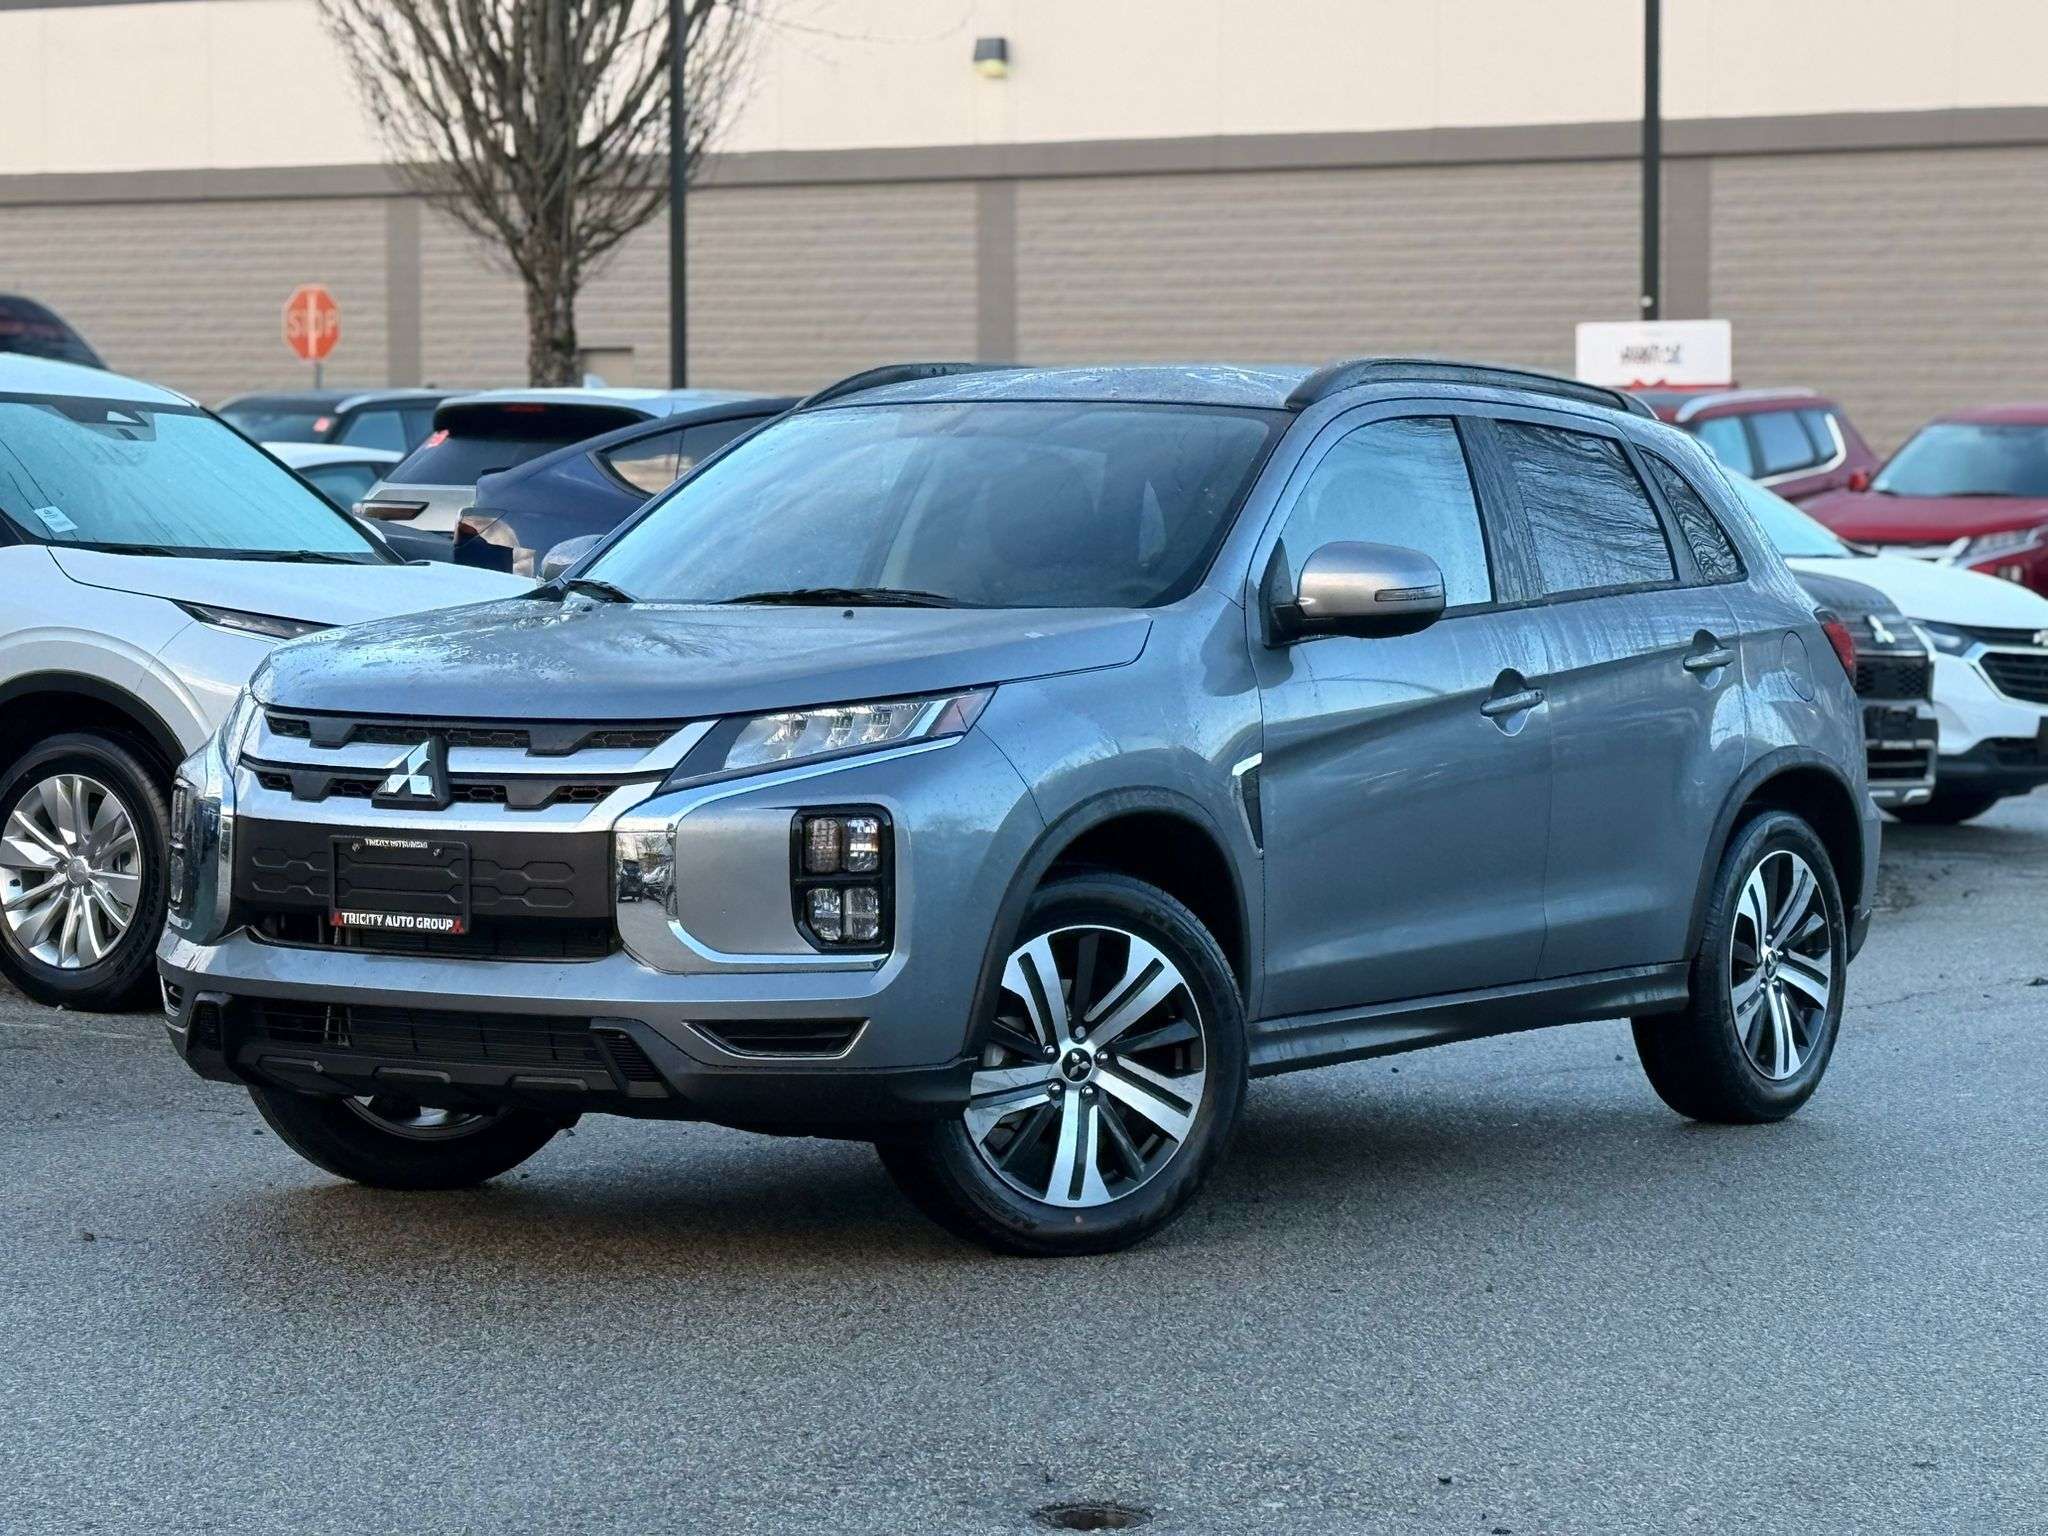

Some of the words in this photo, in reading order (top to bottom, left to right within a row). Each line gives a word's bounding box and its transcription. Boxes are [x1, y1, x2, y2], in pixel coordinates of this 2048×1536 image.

[287, 308, 338, 338] STOP
[341, 912, 384, 926] TRICITY
[385, 914, 414, 928] AUTO
[416, 917, 454, 931] GROUP
